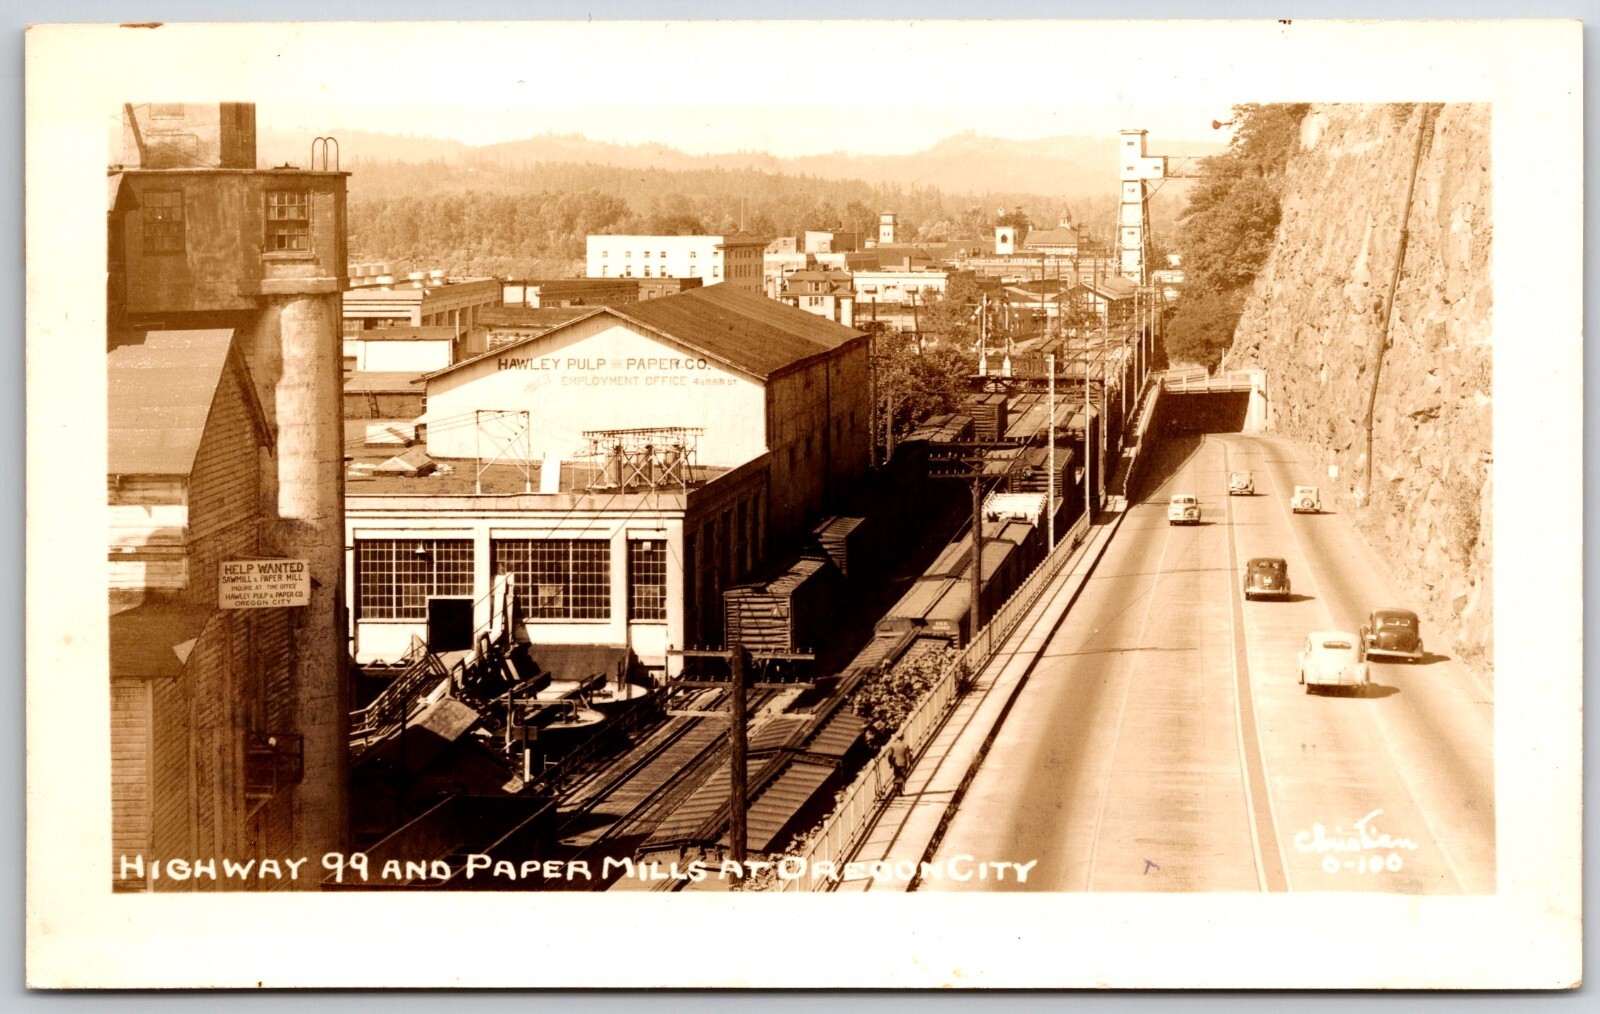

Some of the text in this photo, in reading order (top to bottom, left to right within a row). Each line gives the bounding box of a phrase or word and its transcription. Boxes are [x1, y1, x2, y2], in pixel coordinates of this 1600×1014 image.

[497, 358, 561, 371] HAWLEY
[567, 358, 606, 370] PULP
[626, 358, 680, 370] PAPER
[560, 376, 640, 386] EMPLOYMENT
[645, 376, 688, 386] OFFICE
[224, 562, 304, 575] HELP WANTED
[222, 575, 252, 584] SAWMILL
[260, 574, 283, 582] PAPER
[286, 573, 303, 581] MILL
[253, 592, 268, 600] PULP
